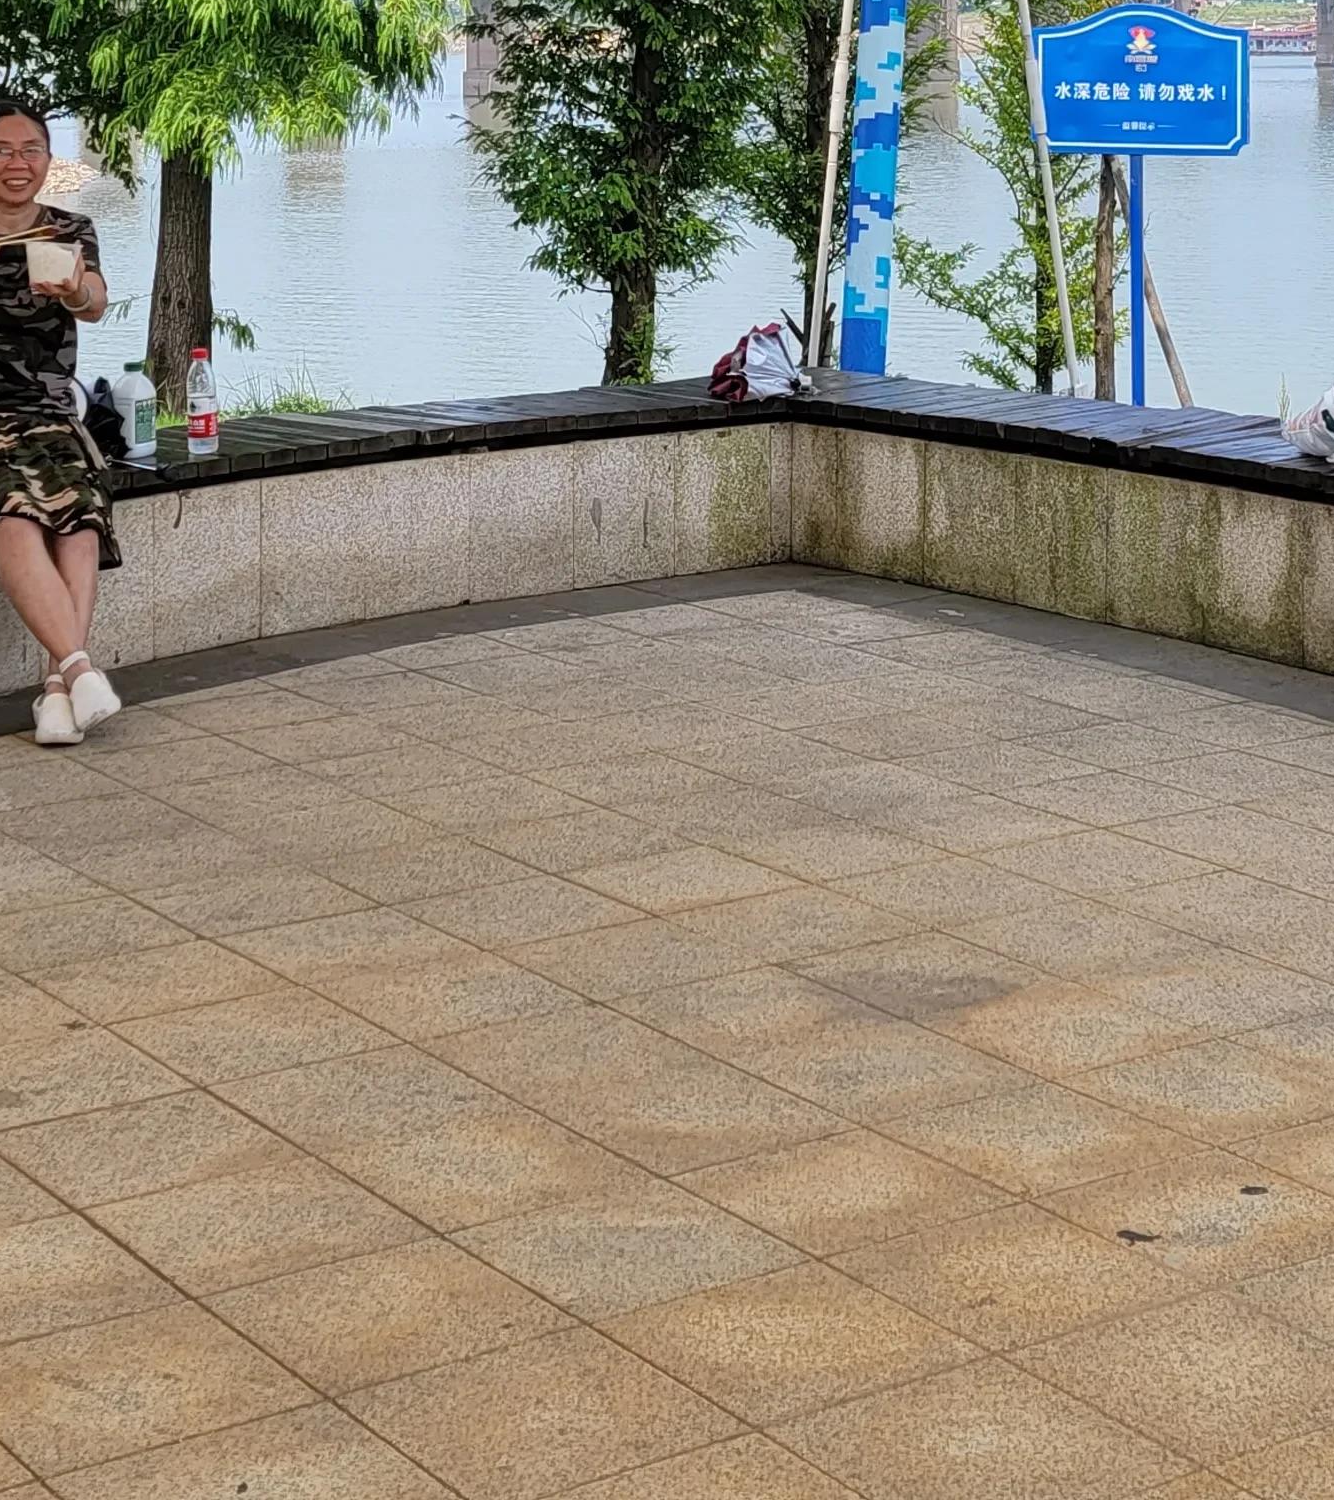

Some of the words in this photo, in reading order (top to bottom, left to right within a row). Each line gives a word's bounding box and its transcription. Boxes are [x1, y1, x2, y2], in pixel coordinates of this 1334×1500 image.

[1055, 81, 1130, 100] 水深危险
[1139, 82, 1227, 101] 请勿戏水！
